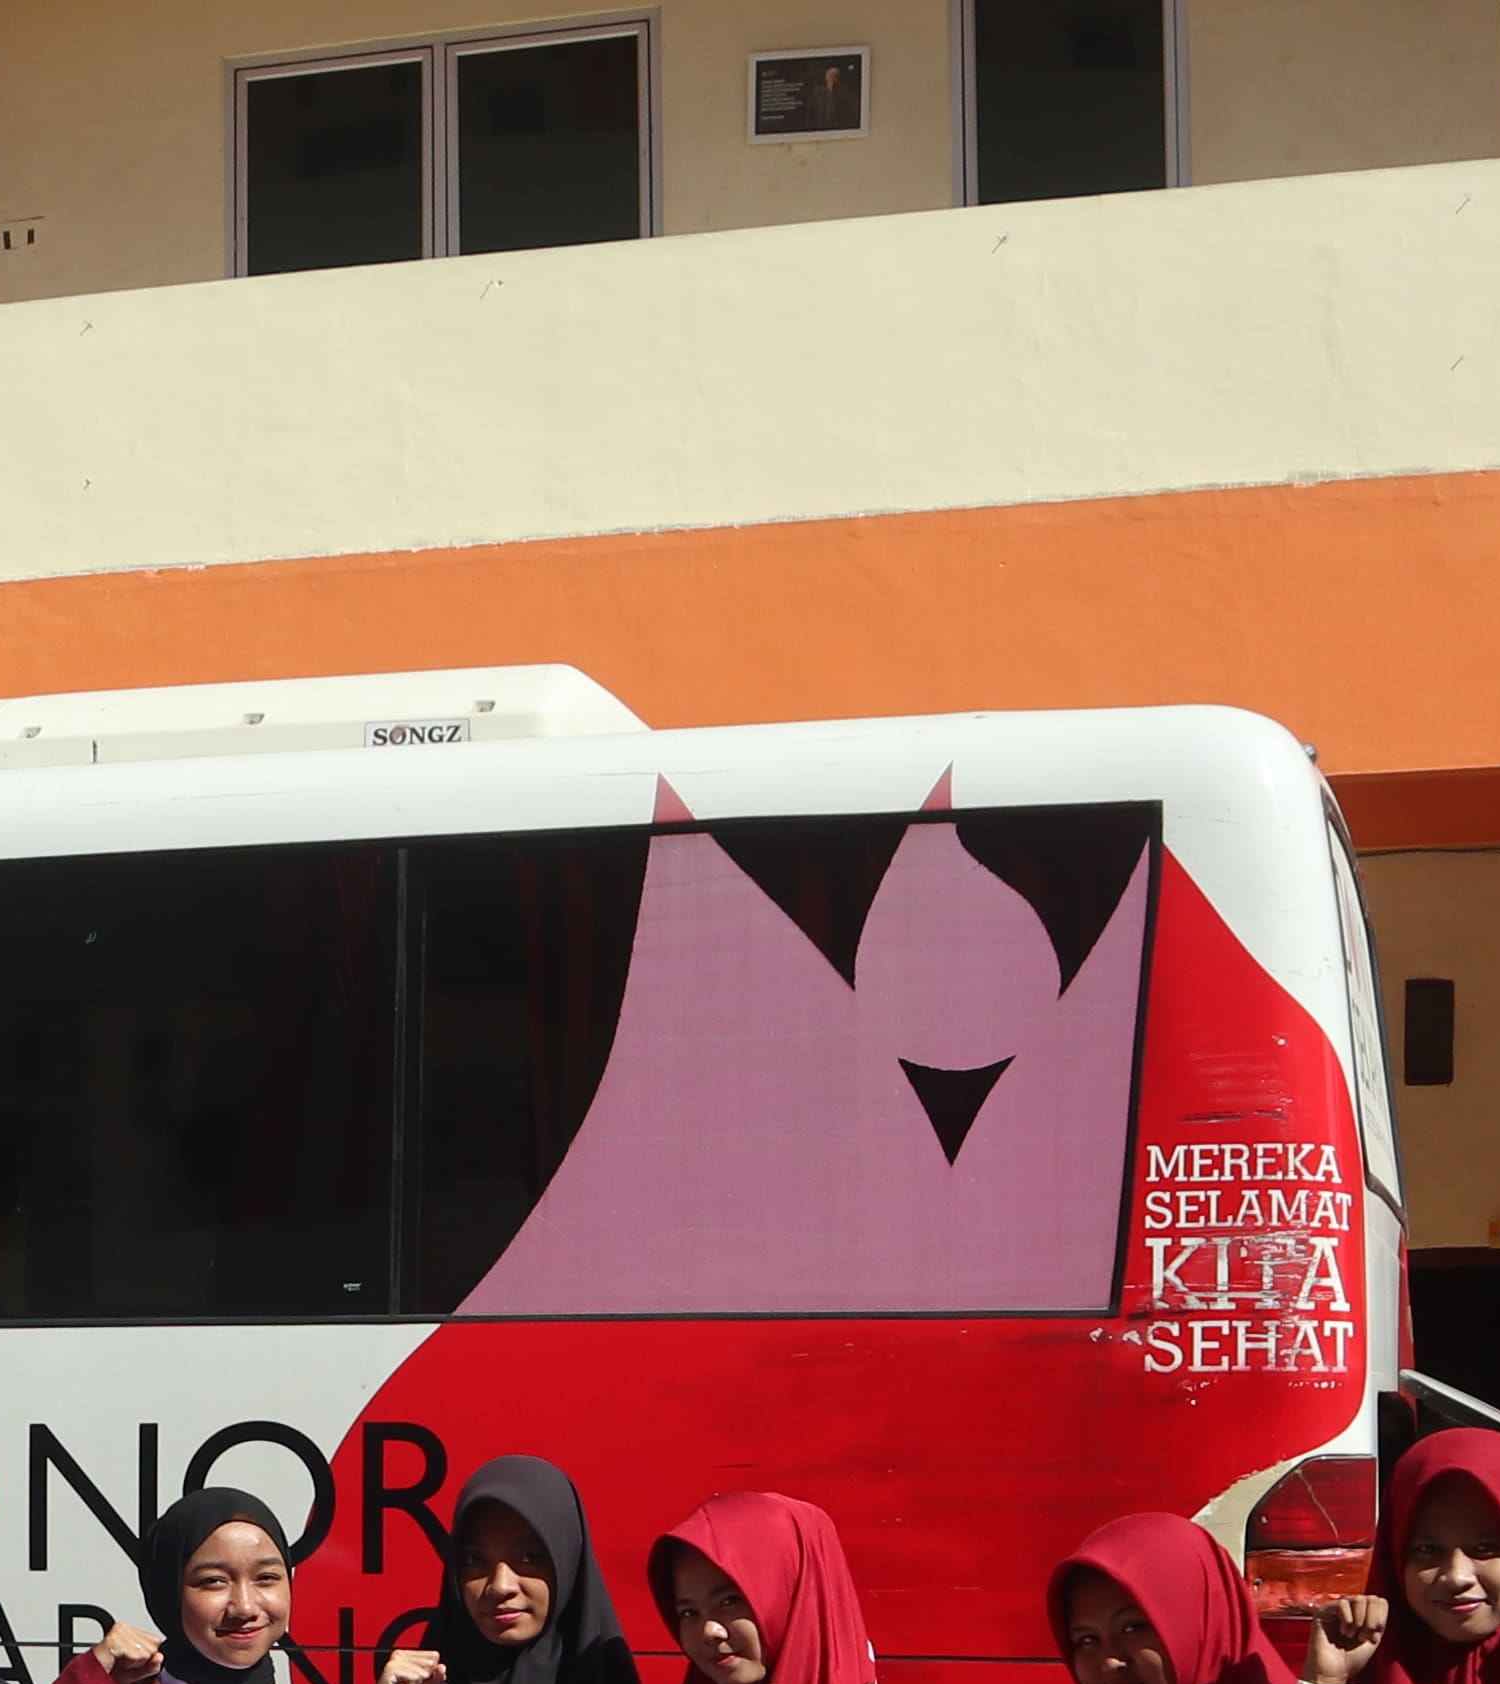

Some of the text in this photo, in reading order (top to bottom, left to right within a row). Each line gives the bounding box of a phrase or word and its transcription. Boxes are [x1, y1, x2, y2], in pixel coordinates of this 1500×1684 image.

[372, 725, 462, 746] SONGZ
[1146, 1144, 1342, 1182] MEREKA
[1144, 1190, 1352, 1230] SELAMAT
[1144, 1237, 1350, 1312] KITA
[1143, 1321, 1354, 1373] SEHAT
